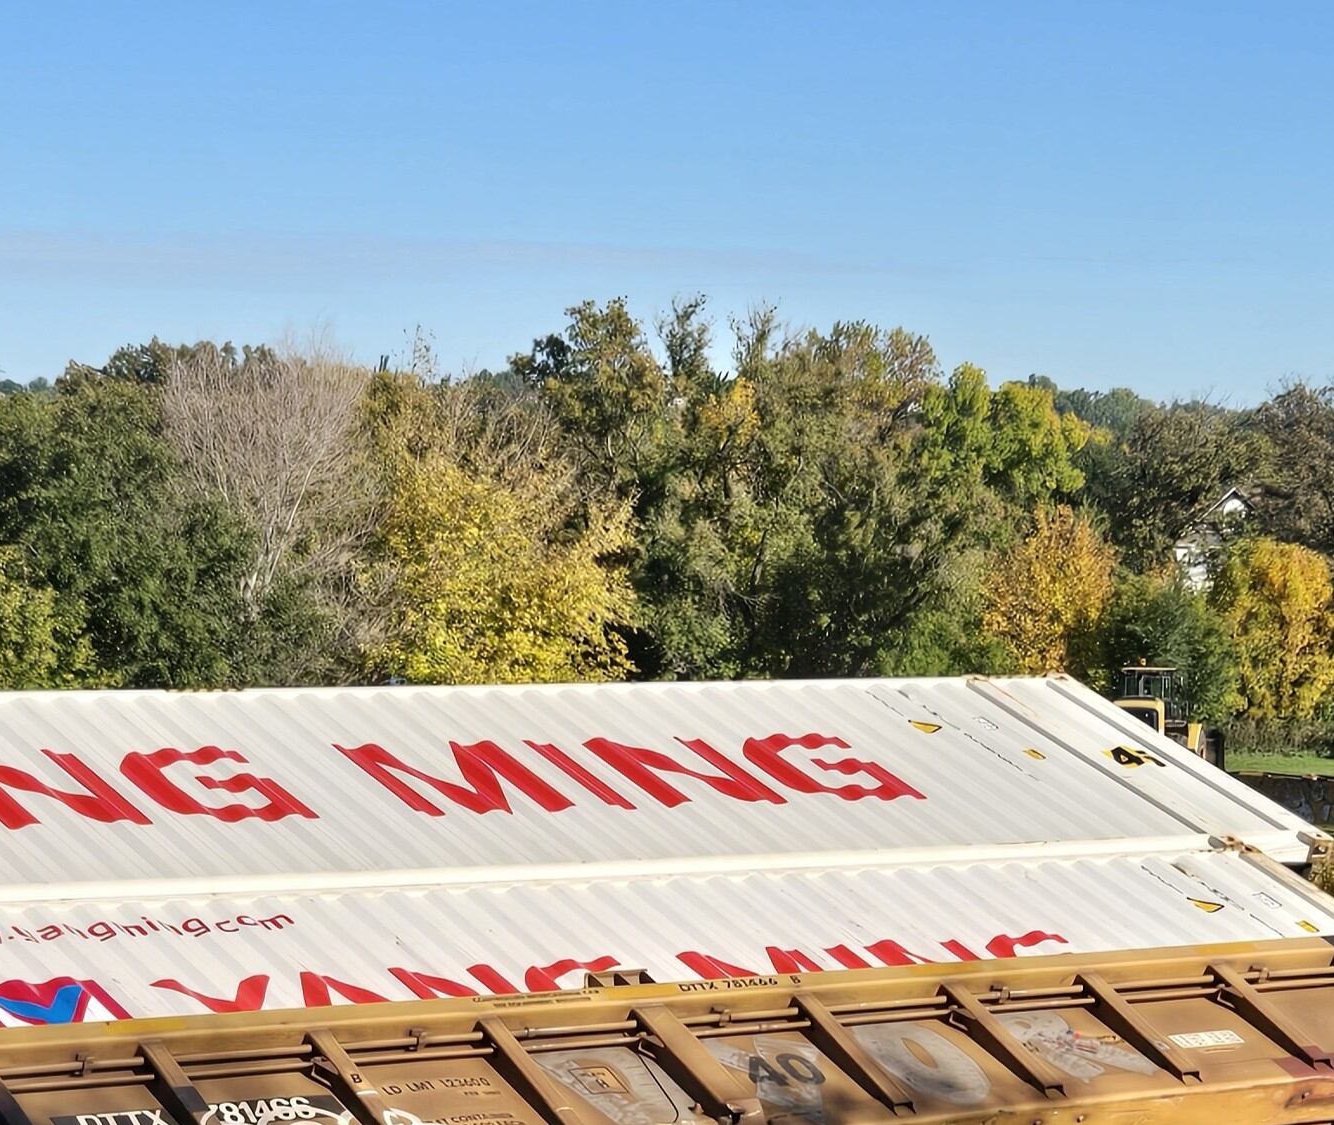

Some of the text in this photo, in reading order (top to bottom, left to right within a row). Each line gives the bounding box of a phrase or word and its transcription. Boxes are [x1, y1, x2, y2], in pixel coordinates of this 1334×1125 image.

[331, 732, 928, 817] MING
[678, 982, 719, 993] DTTX
[721, 975, 779, 991] 781466
[350, 1073, 362, 1083] B
[381, 1085, 402, 1095] LD
